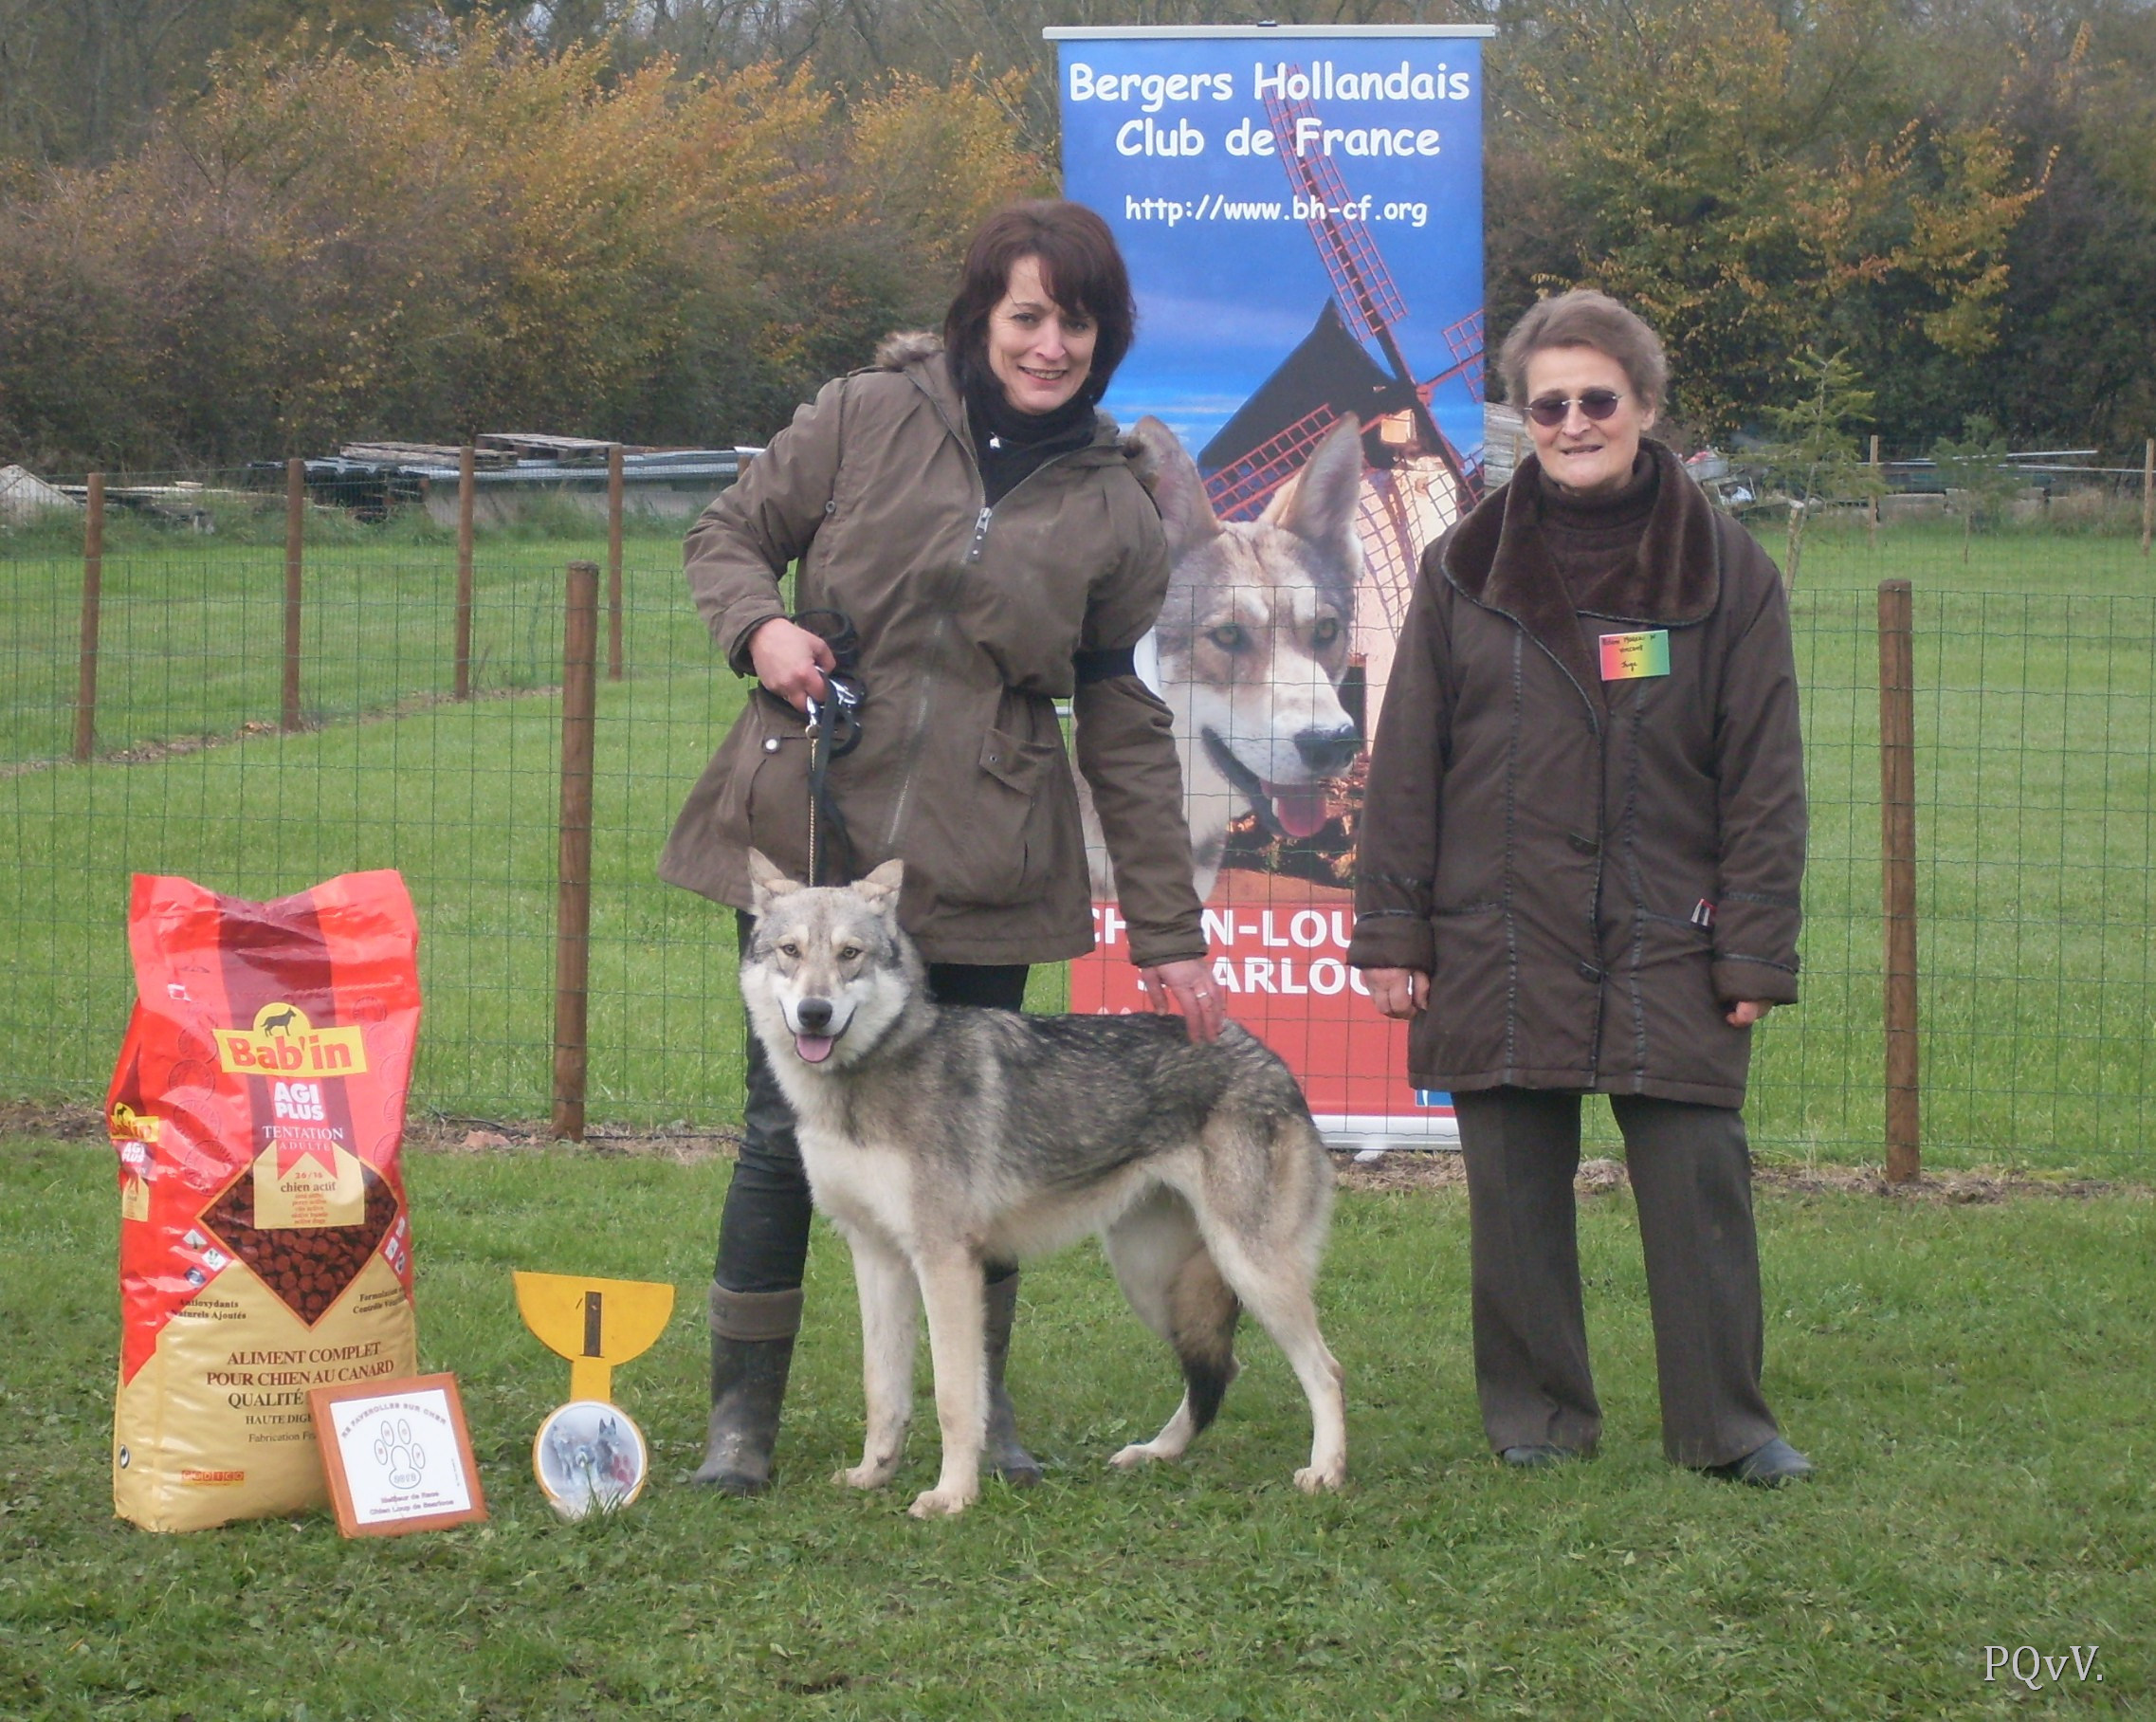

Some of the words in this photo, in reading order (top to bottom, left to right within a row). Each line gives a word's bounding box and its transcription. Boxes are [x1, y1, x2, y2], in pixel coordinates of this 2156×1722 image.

[1069, 63, 1233, 112] Bergers
[1254, 61, 1470, 101] Hollandais
[1116, 118, 1204, 156] Club
[1226, 118, 1275, 156] de
[1296, 118, 1440, 156] France
[1125, 194, 1428, 227] http://www.bh-cf.org
[227, 1035, 352, 1071] Bab'in
[274, 1082, 320, 1104] AGI
[275, 1102, 324, 1121] PLUS
[262, 1126, 343, 1141] TENTATION
[280, 1142, 331, 1152] ADULTE
[281, 1182, 310, 1193] chien
[313, 1182, 337, 1192] actif
[179, 1299, 239, 1309] Antioxydants
[211, 1311, 247, 1320] Ajoutés
[227, 1350, 306, 1365] ALIMENT
[308, 1342, 381, 1364] COMPLET
[207, 1372, 254, 1385] POUR
[257, 1371, 311, 1385] CHIEN
[313, 1370, 335, 1383] AU
[338, 1360, 394, 1382] CANARD
[228, 1388, 304, 1409] QUALITÉ
[246, 1415, 285, 1424] HAUTE
[248, 1433, 300, 1443] Fabrication
